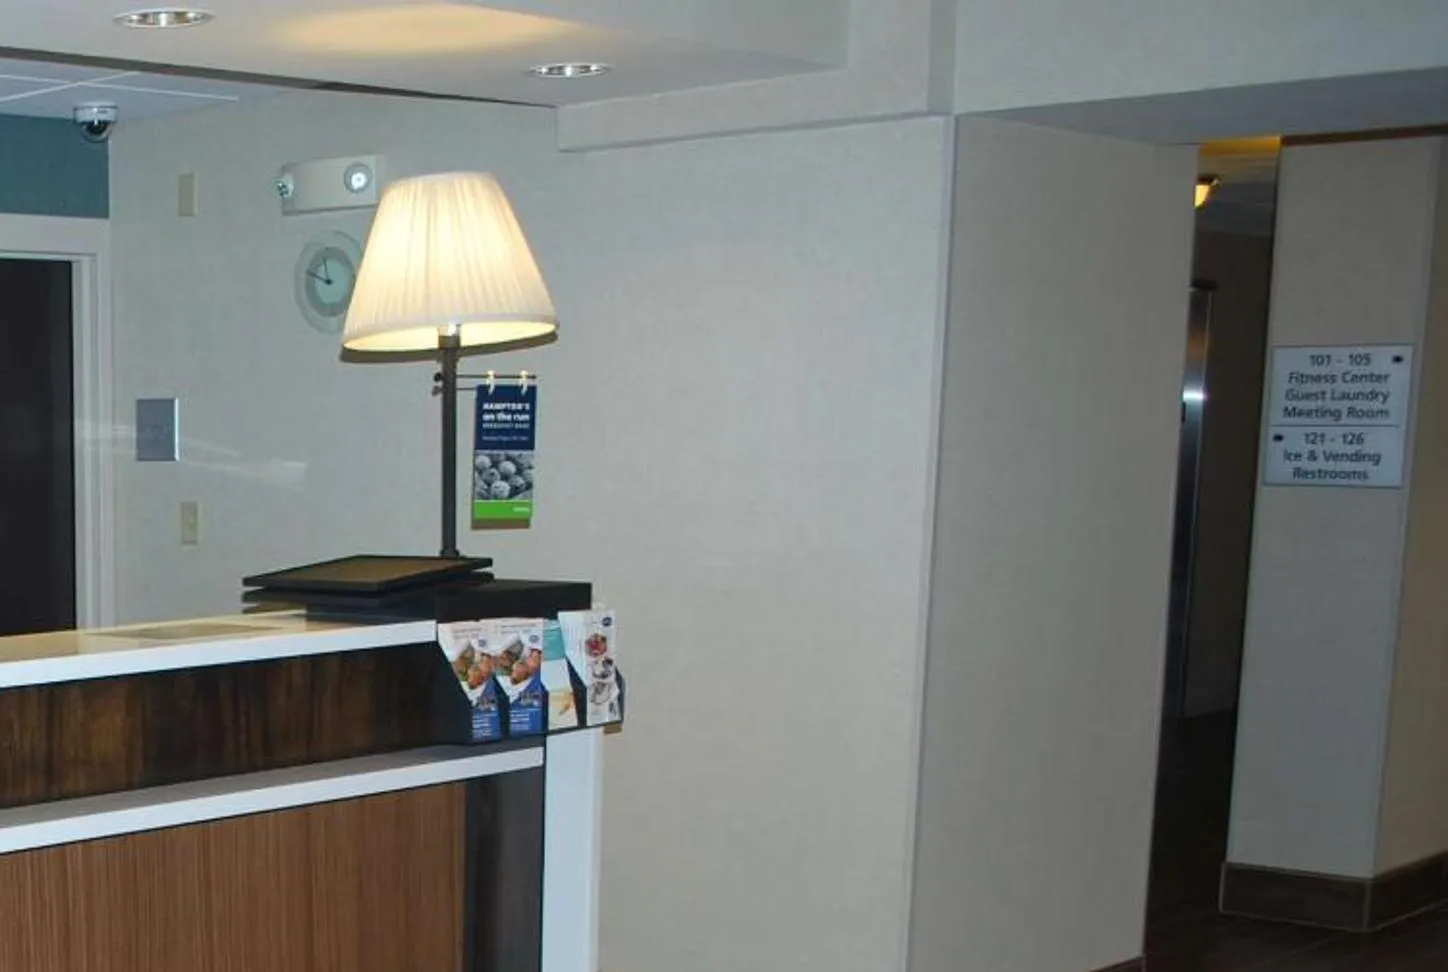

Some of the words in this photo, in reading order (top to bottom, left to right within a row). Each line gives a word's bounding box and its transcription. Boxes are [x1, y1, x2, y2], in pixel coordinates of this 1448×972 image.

[1309, 354, 1332, 366] 101
[1348, 353, 1372, 366] 105
[1288, 371, 1337, 384] Fitness
[1341, 371, 1390, 384] Center
[1285, 388, 1327, 401] Guest
[1330, 388, 1390, 404] Laundry
[1283, 406, 1342, 421] Meeting
[1346, 406, 1390, 419] Room
[1304, 432, 1326, 445] 121
[1342, 432, 1365, 445] 126
[1283, 449, 1302, 462] Ice
[1307, 449, 1318, 462] &
[1323, 449, 1382, 466] Vending
[1292, 467, 1369, 481] Restrooms
